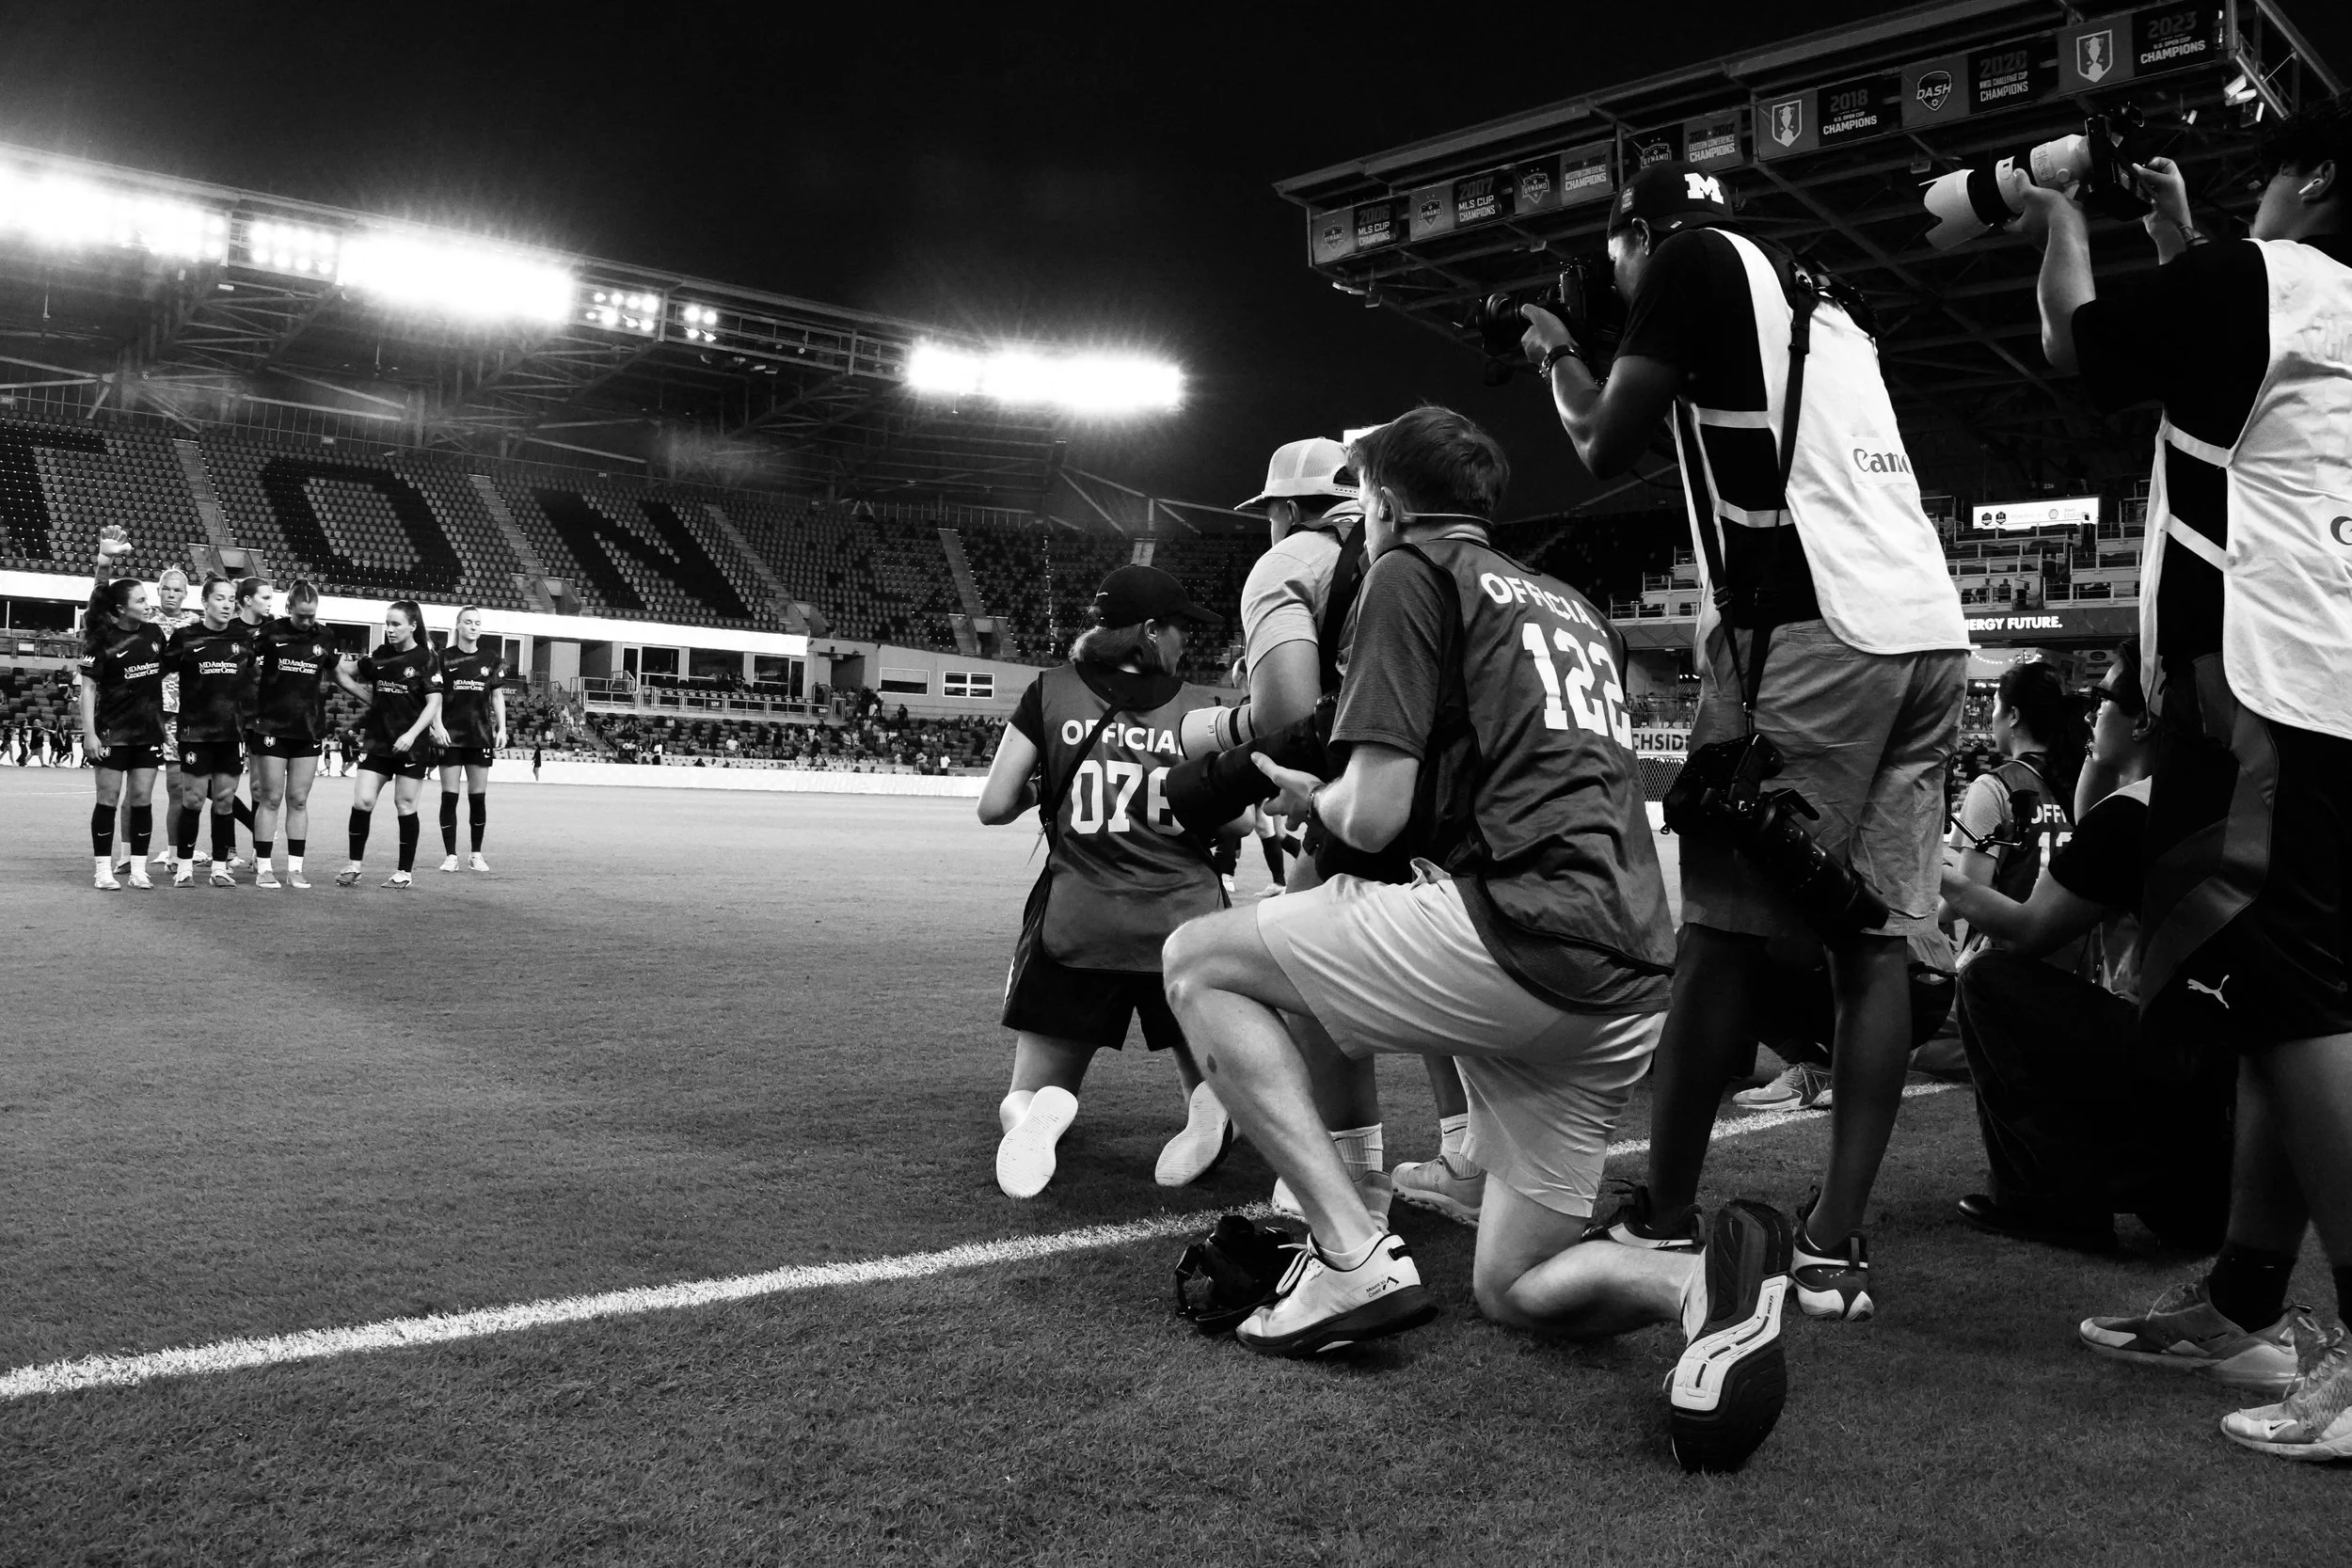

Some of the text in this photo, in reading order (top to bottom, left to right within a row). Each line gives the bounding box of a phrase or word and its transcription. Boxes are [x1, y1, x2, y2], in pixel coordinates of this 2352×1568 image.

[2147, 10, 2198, 39] 2023
[2140, 40, 2206, 64] CHAMPIONS
[1979, 50, 2028, 79] 2020
[1830, 88, 1868, 113] 2018
[1916, 82, 1952, 101] DASH
[1980, 81, 2028, 102] CHAMPIONS
[1822, 115, 1878, 135] CHAMPIONS
[1690, 142, 1735, 163] CHAMPIONS
[1459, 176, 1495, 200] 2007
[1523, 182, 1548, 195] DYNAMO
[1565, 172, 1606, 191] CHAMPIONS
[1684, 172, 1724, 204] M
[1458, 195, 1495, 212] MLS CUP
[1458, 204, 1496, 223] CHAMPIONS
[1419, 208, 1442, 220] DYNAMO
[1359, 221, 1391, 235] MLS CUP
[1359, 230, 1391, 246] CHAMPIONS
[1853, 449, 1912, 474] Cano
[2007, 616, 2063, 630] FUTURE.
[1521, 622, 1633, 751] 122
